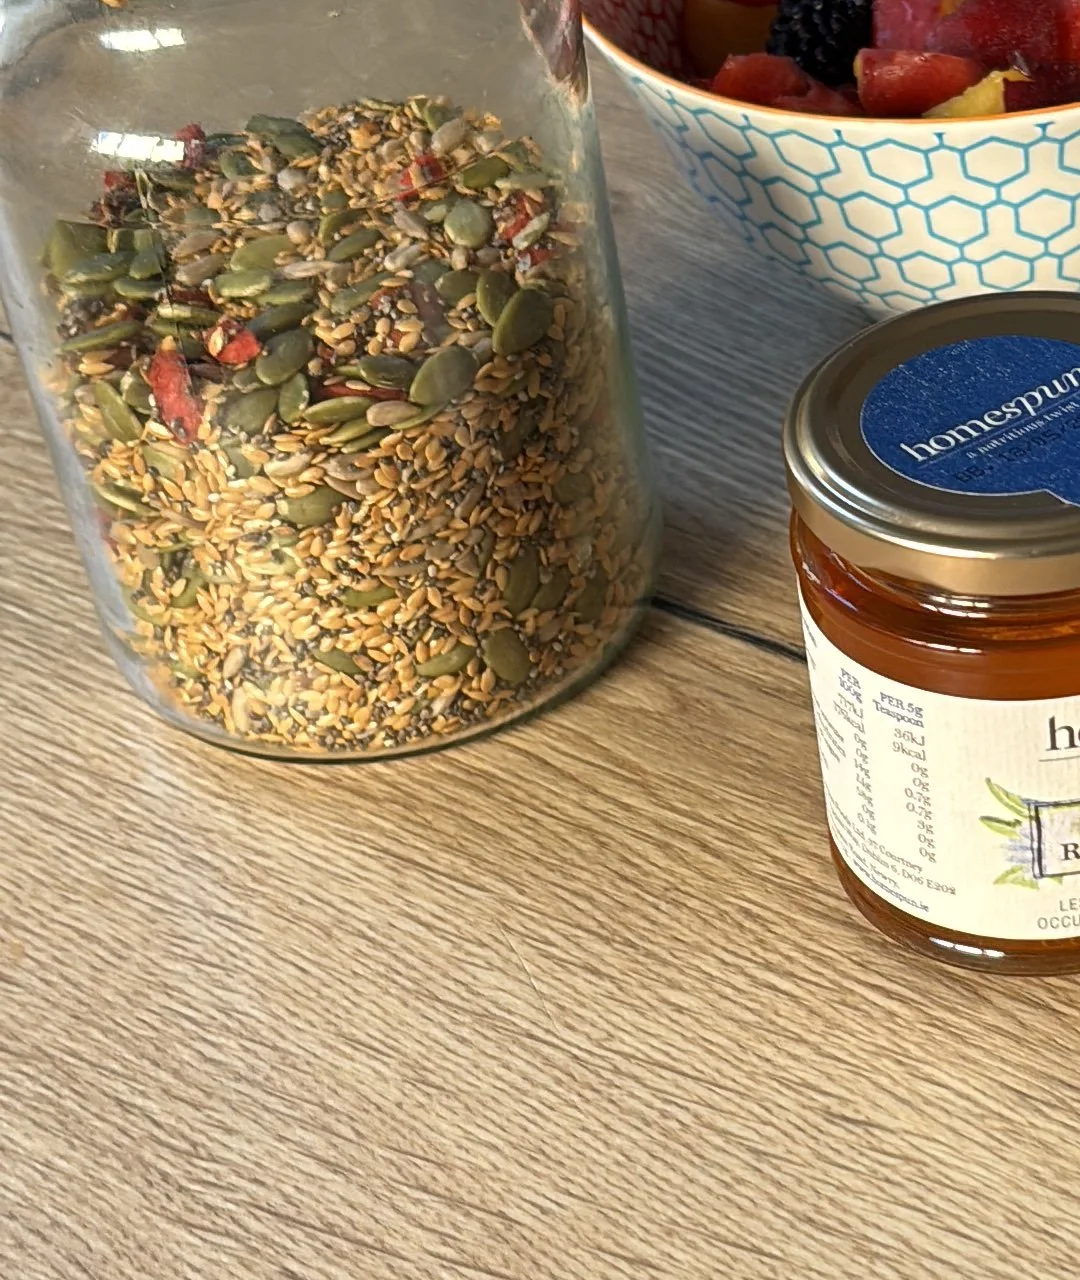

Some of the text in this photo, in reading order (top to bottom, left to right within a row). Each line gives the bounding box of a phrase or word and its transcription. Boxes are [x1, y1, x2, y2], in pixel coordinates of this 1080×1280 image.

[872, 699, 925, 729] Teaspoon
[880, 691, 924, 720] PER 5g
[893, 740, 928, 762] 9kcal
[911, 763, 929, 778] 0g
[912, 777, 930, 793] 0g
[904, 787, 932, 808] 0.7g
[906, 802, 933, 821] 0.7g
[917, 819, 935, 836] 3g
[918, 833, 936, 850] 0g
[919, 847, 937, 864] 0g
